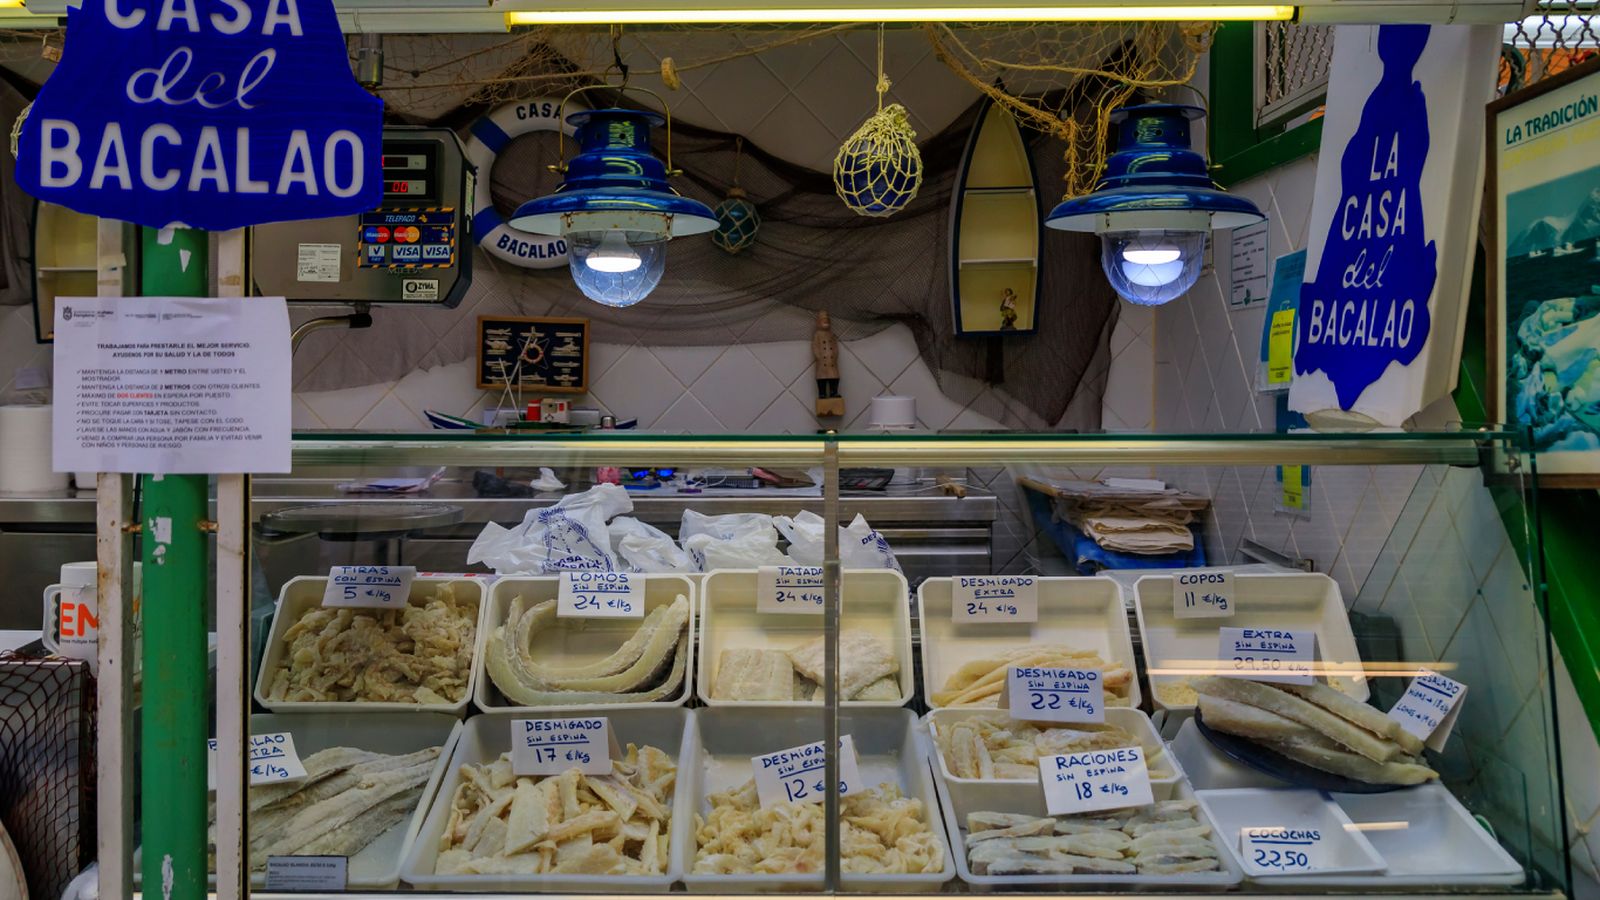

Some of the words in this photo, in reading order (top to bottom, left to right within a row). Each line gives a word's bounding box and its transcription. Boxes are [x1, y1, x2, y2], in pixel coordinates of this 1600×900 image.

[126, 46, 277, 109] del
[1506, 124, 1522, 144] LA
[1525, 94, 1598, 136] TRADICIÓN
[40, 119, 365, 198] BACALAO
[1370, 132, 1398, 182] LA
[1342, 188, 1406, 240] CASA
[396, 247, 418, 256] VISA
[425, 246, 448, 256] VISA
[497, 234, 567, 258] BACALAO
[1342, 244, 1394, 289] del
[1308, 298, 1414, 348] BACALAO
[342, 566, 388, 575] TIRAS
[571, 573, 628, 582] LOMOS
[1180, 574, 1224, 584] COPOS
[344, 586, 357, 600] 5
[776, 591, 796, 602] 24
[1185, 592, 1195, 607] 11
[574, 595, 600, 610] 24
[967, 602, 987, 614] 24
[1243, 630, 1293, 640] EXTRA
[1016, 668, 1097, 680] DESMIGADO
[1031, 693, 1061, 710] 22
[536, 748, 556, 763] 17
[785, 779, 808, 802] 12
[1075, 782, 1092, 800] 18
[1249, 830, 1320, 840] COCOCHAS
